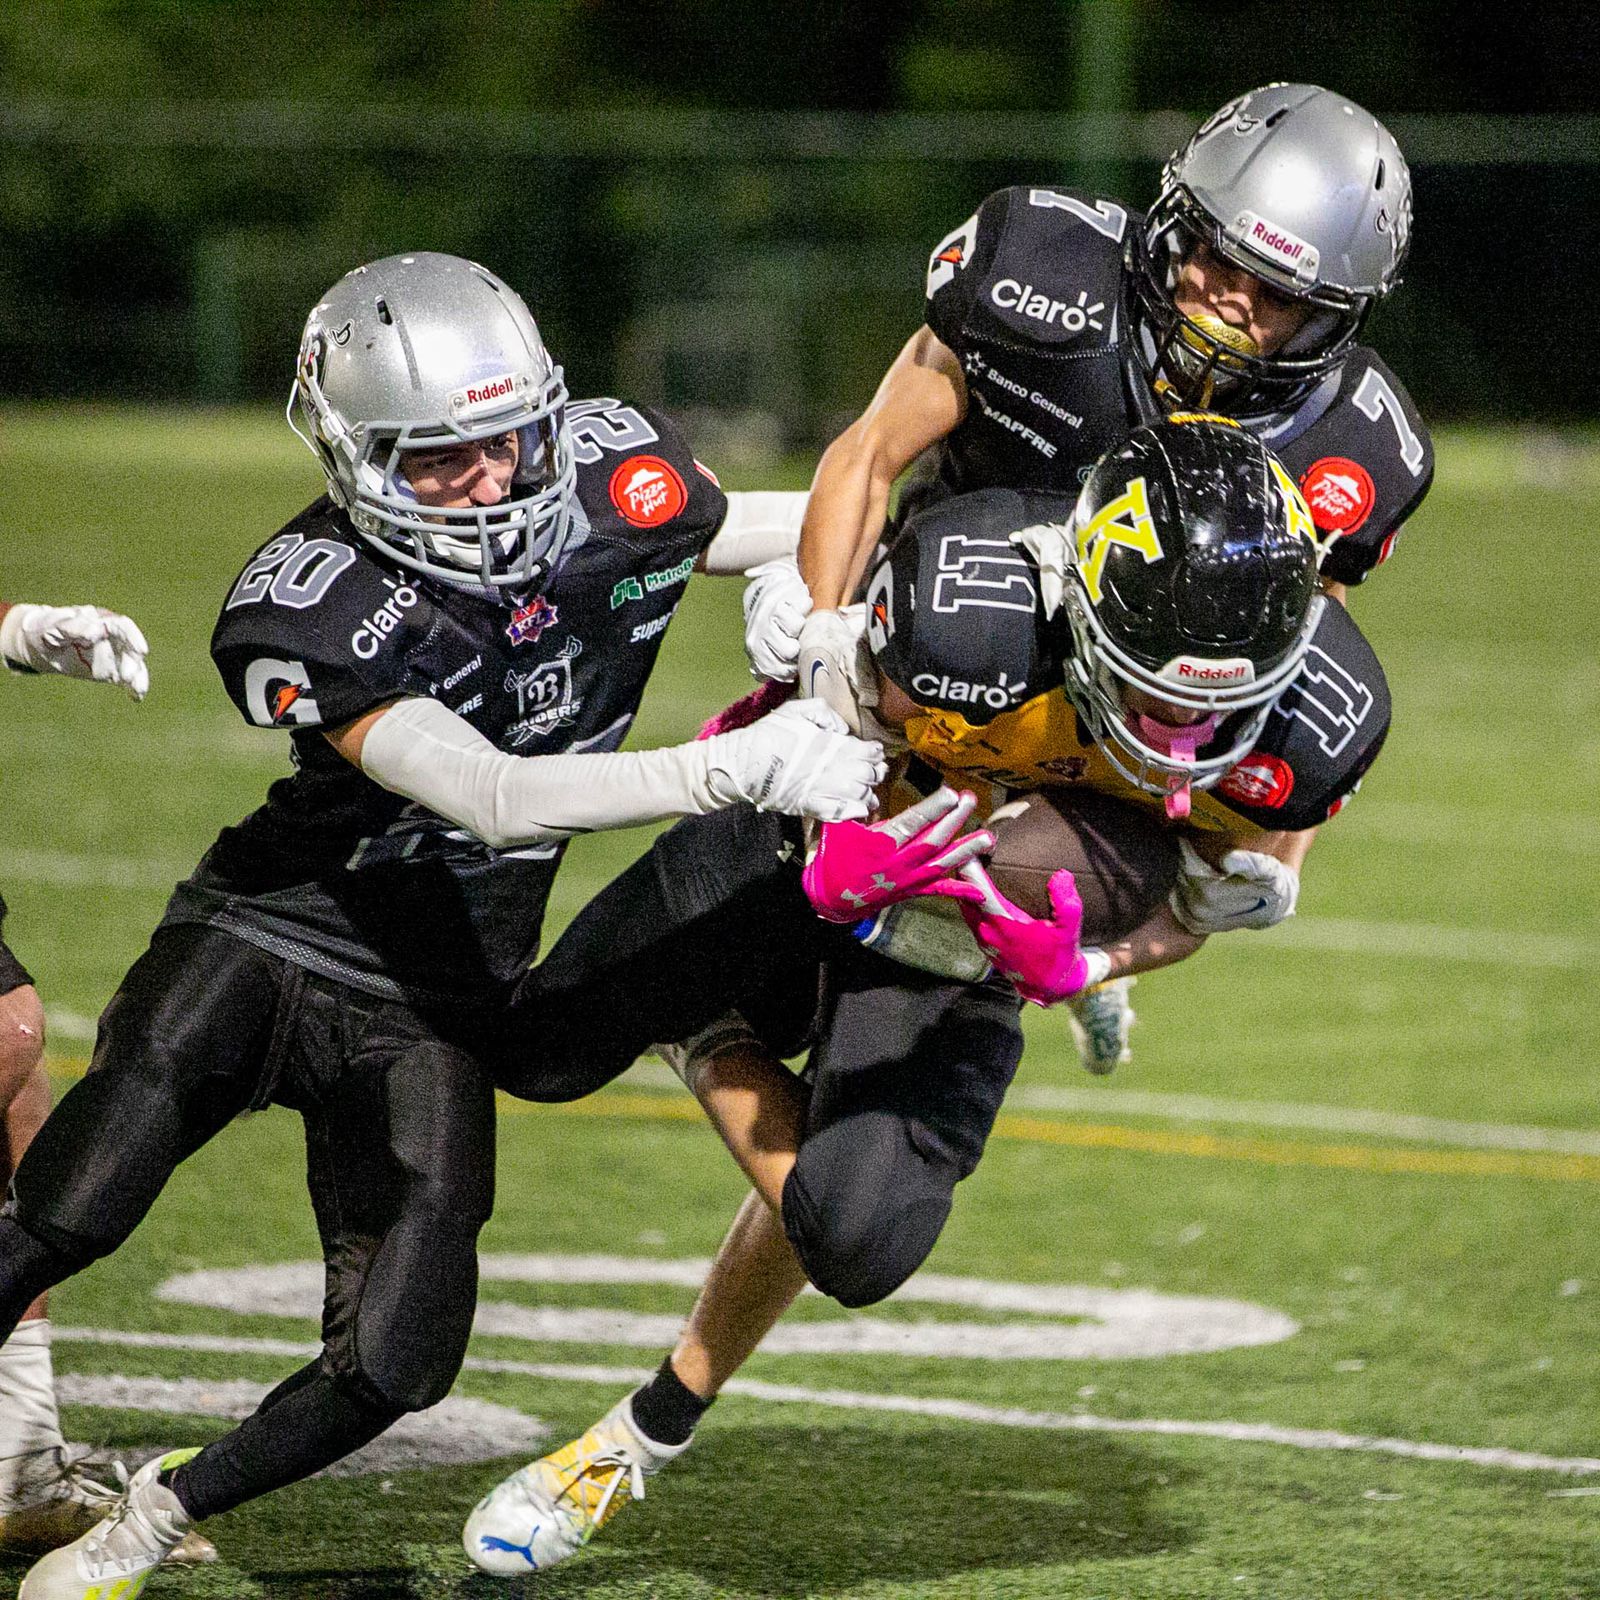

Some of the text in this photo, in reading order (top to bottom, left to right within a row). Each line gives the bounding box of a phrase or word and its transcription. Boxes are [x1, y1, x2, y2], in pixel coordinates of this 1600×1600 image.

[1029, 189, 1128, 243] 7
[1252, 221, 1304, 259] Riddell
[990, 278, 1087, 332] Claro
[467, 377, 515, 405] Riddell
[986, 367, 1084, 429] Banco General
[984, 405, 1058, 459] MAPFRE
[1352, 366, 1424, 477] 7
[628, 479, 668, 512] Pizza
[641, 491, 669, 517] Hut
[1311, 479, 1354, 510] Pizza
[1311, 495, 1347, 517] Hut
[225, 533, 357, 612] 20
[932, 535, 1037, 613] 11
[351, 586, 418, 659] Claro
[443, 655, 483, 690] General
[911, 672, 1009, 709] Claro
[1177, 663, 1246, 680] Riddell
[1274, 644, 1374, 758] 11
